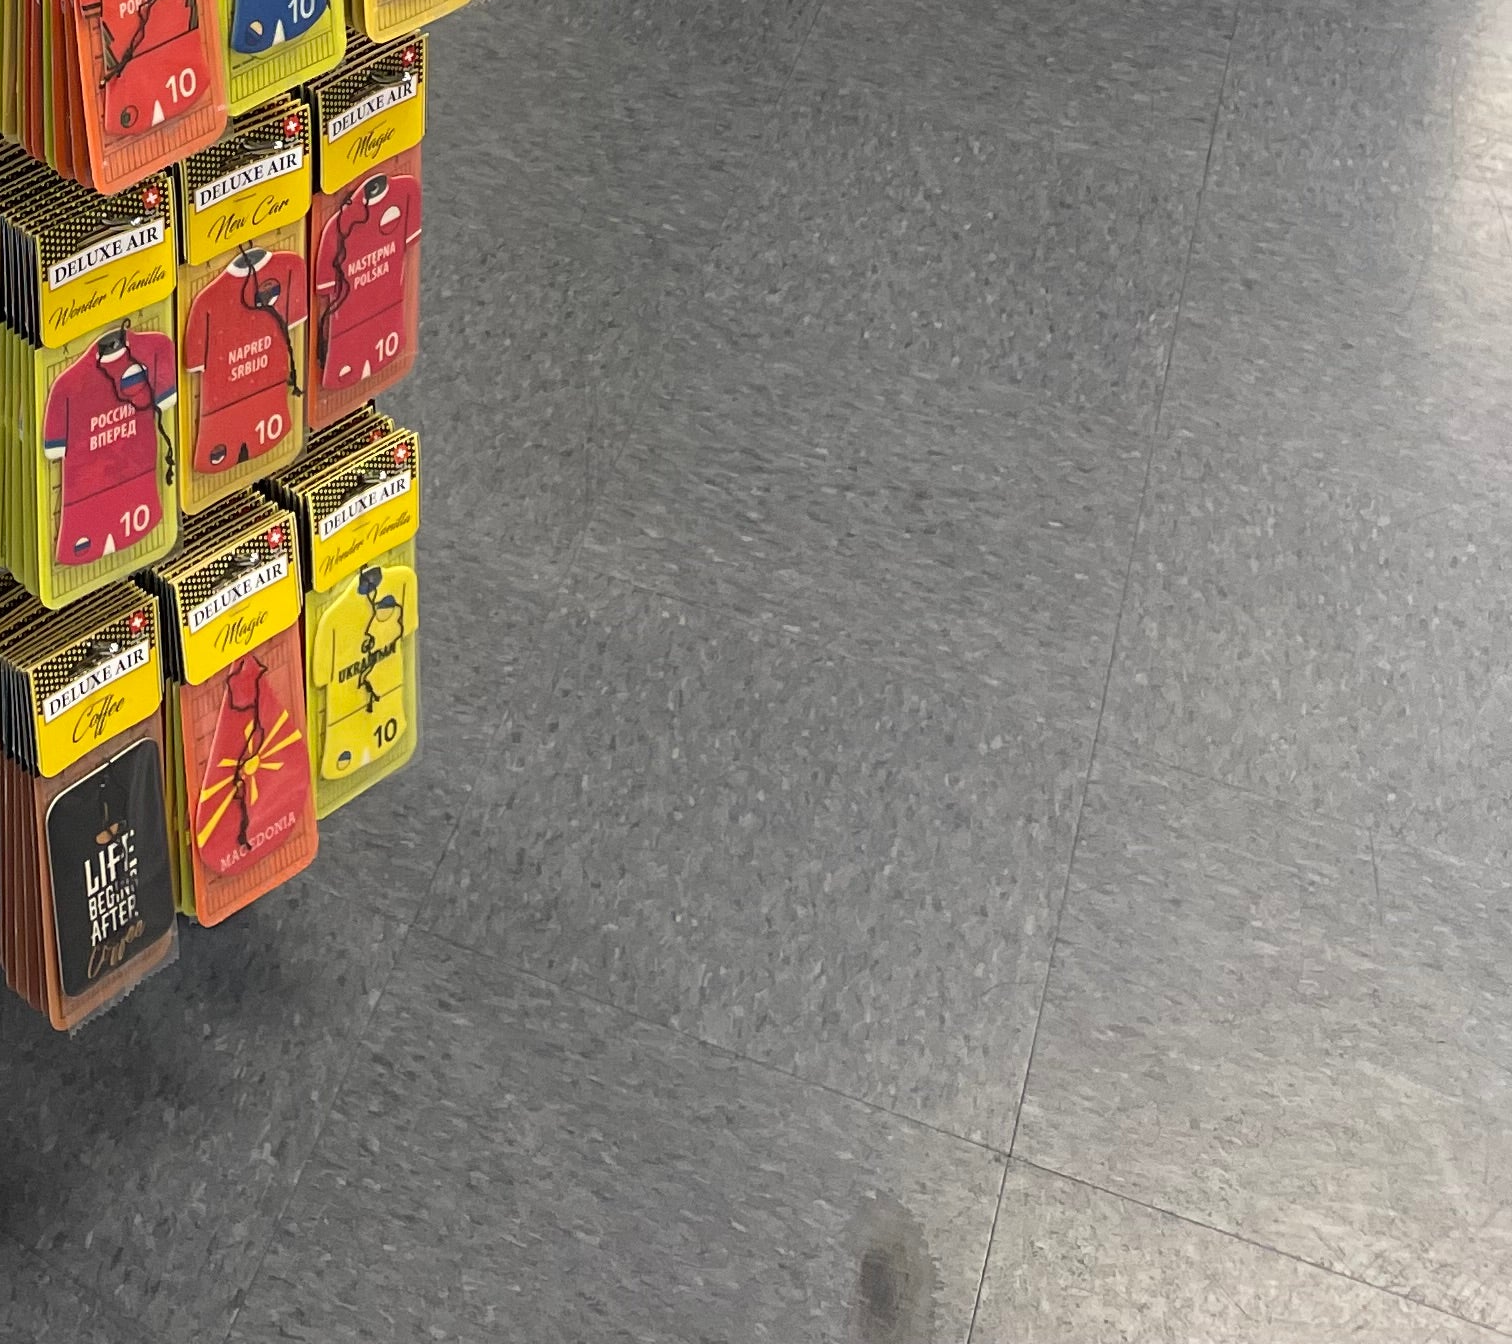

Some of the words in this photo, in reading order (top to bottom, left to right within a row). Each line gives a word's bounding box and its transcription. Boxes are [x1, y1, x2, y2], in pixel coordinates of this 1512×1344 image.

[165, 68, 197, 104] 10
[347, 241, 398, 280] NASTĘPNA
[353, 261, 391, 290] POLSKA
[227, 335, 273, 366] NAPRED
[375, 331, 399, 364] 10
[229, 354, 270, 384] SRBIJO
[89, 403, 137, 435] РОССИЯ
[89, 421, 138, 452] ВПЕРЕД
[119, 504, 150, 539] 10
[48, 665, 109, 718] DELUXE
[112, 645, 146, 680] AIR
[71, 696, 126, 745] Coffee
[372, 717, 398, 751] 10
